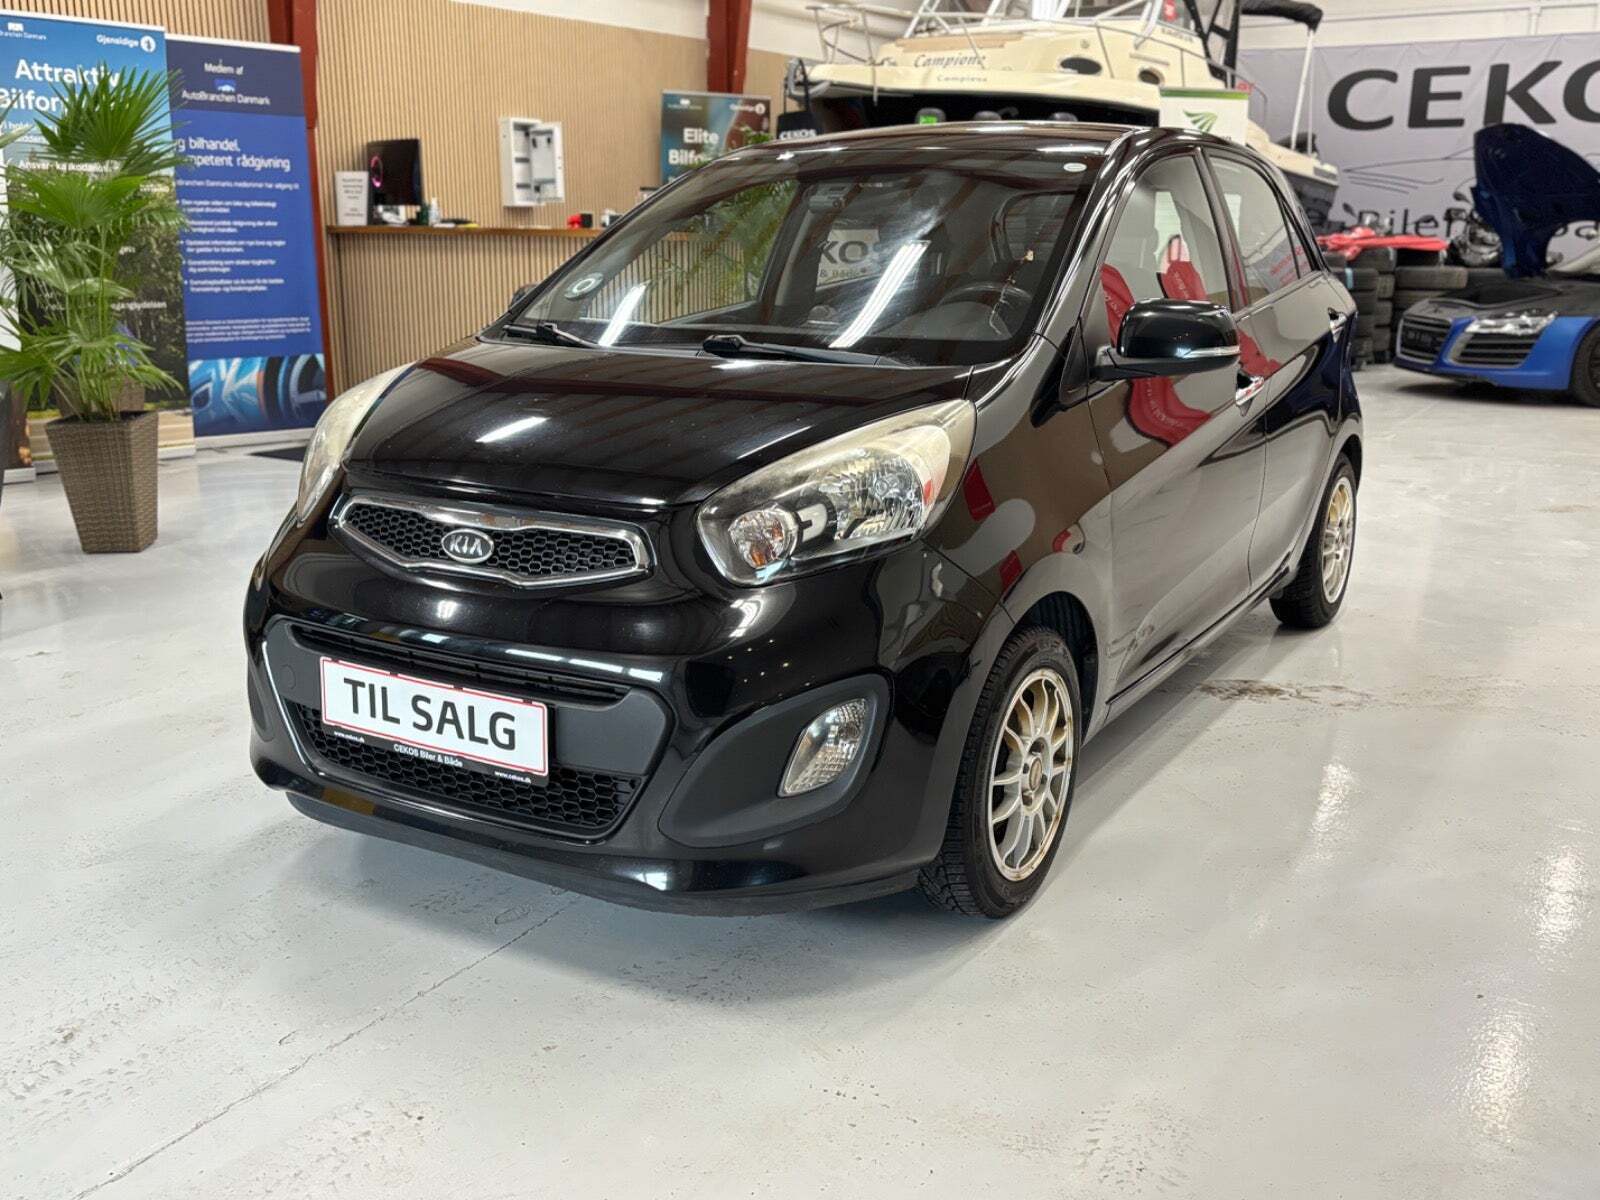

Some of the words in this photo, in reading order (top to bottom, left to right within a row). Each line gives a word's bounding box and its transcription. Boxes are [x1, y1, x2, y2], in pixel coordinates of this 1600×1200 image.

[96, 34, 139, 48] Gjensidige
[182, 90, 236, 103] AutoBranchen
[237, 94, 271, 105] Danmark
[683, 127, 720, 144] Elite
[237, 153, 292, 172] rådgivning
[449, 534, 483, 557] KIA
[343, 677, 400, 725] TIL
[411, 694, 516, 751] SALG
[393, 743, 419, 757] CEKOS
